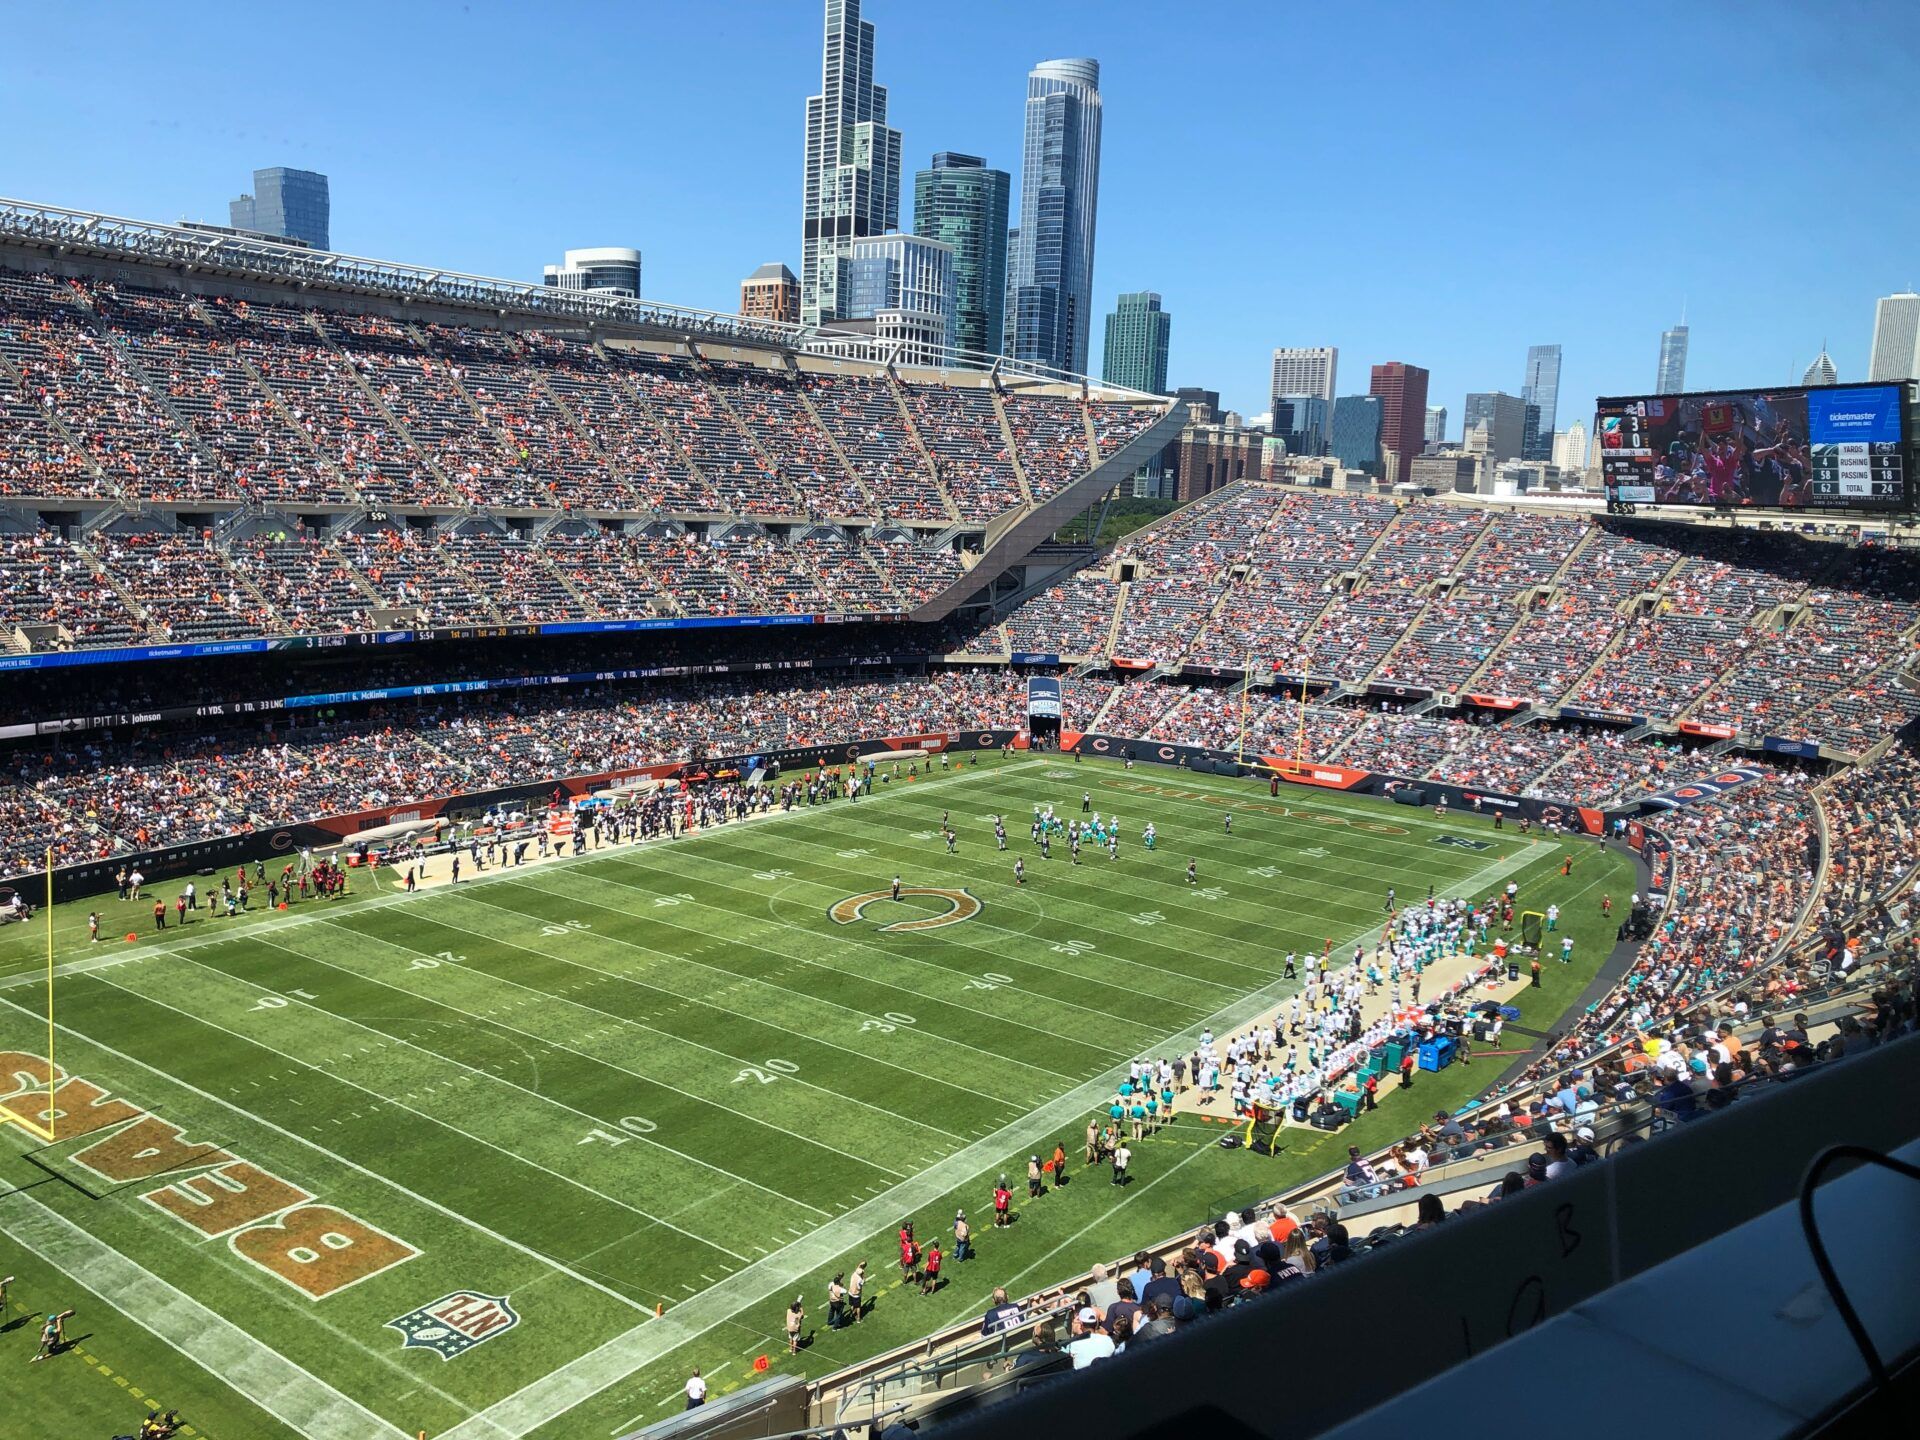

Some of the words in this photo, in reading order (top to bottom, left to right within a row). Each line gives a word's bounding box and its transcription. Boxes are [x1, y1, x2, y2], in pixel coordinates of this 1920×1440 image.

[1830, 412, 1876, 421] ticketmaster
[1632, 417, 1638, 432] 3
[1632, 433, 1640, 448] 0
[1822, 458, 1828, 466] 4
[1883, 457, 1889, 466] 6
[1820, 470, 1831, 480] 58
[1882, 470, 1892, 480] 18
[1821, 484, 1831, 493] 62
[1882, 484, 1893, 494] 24
[1613, 502, 1634, 513] 5:54
[306, 637, 313, 648] 3
[360, 634, 367, 644] 0
[419, 632, 435, 640] 5:54
[498, 628, 507, 637] 20
[527, 627, 536, 635] 24
[148, 649, 182, 657] ticketmaster
[524, 677, 539, 686] DAL
[329, 693, 346, 703] DET
[361, 690, 388, 700] McKinley
[474, 681, 486, 689] LNG
[93, 716, 112, 727] PIT
[132, 713, 161, 725] Johnson
[197, 707, 206, 716] 41
[208, 706, 224, 715] YDS,
[235, 704, 240, 712] 0
[260, 701, 269, 709] 33
[270, 700, 284, 709] LNG
[1098, 780, 1410, 835] CHICAGO
[752, 868, 794, 880] 50
[656, 892, 695, 907] 40
[542, 920, 592, 935] 30
[1052, 940, 1096, 957] 50
[413, 951, 467, 969] 20
[976, 972, 1014, 991] 40
[258, 988, 319, 1008] 10
[867, 1011, 917, 1034] 30
[742, 1058, 800, 1085] 20
[592, 1116, 658, 1147] 10
[434, 1295, 509, 1338] NFL
